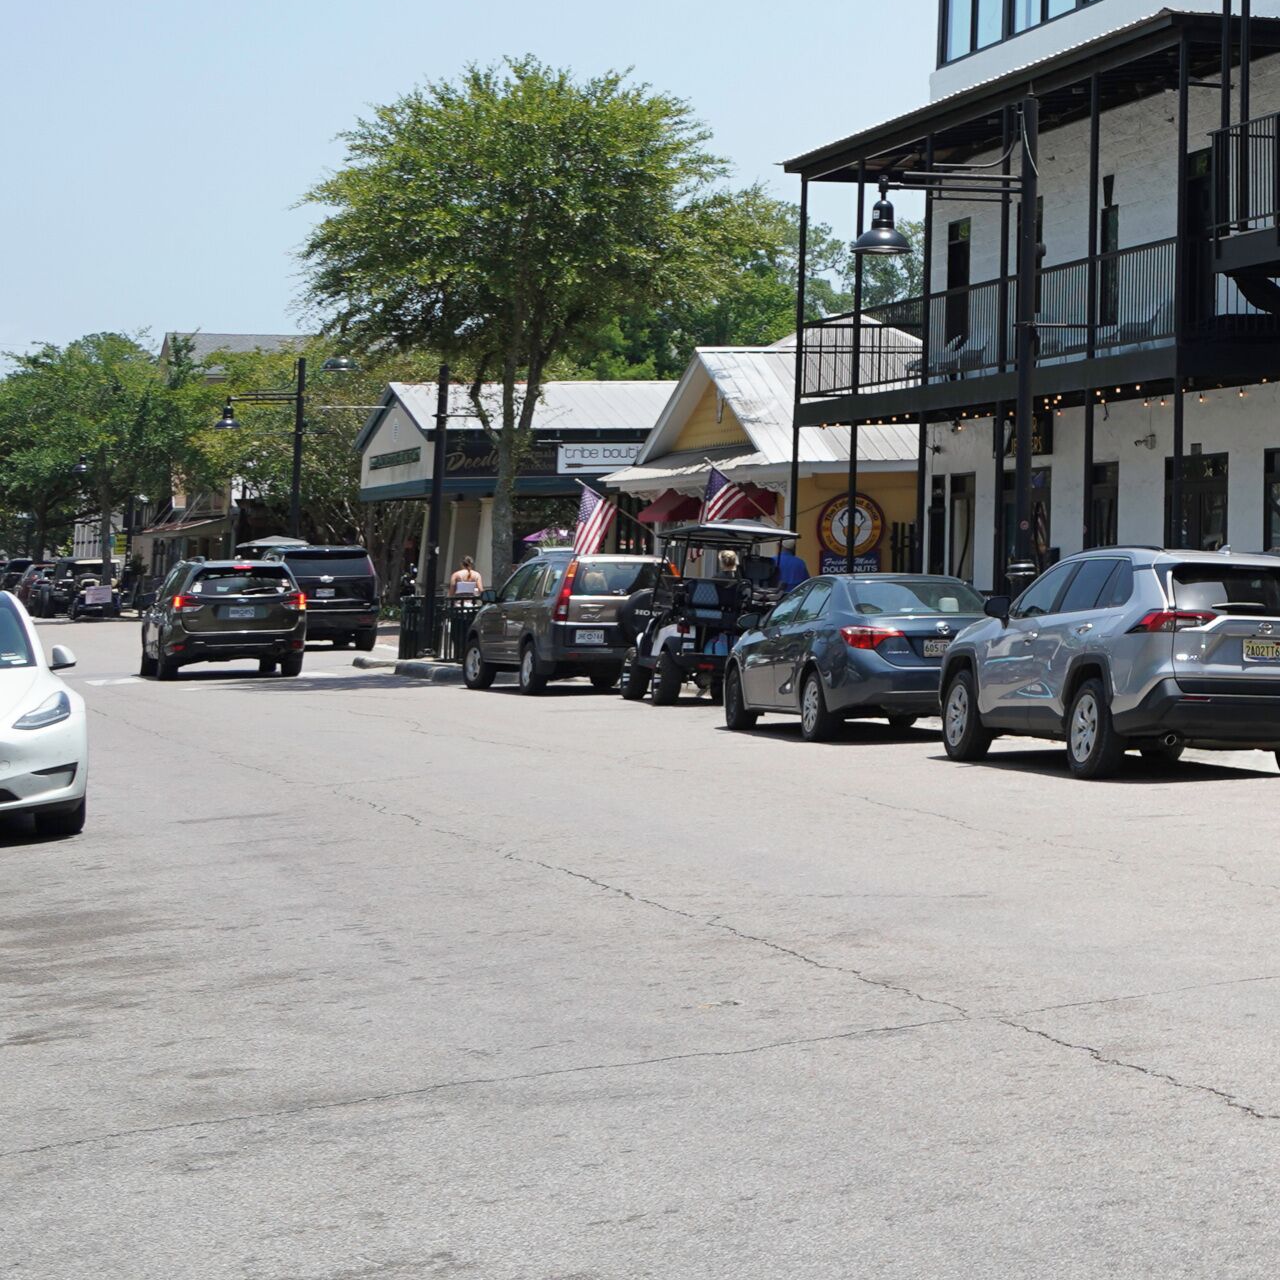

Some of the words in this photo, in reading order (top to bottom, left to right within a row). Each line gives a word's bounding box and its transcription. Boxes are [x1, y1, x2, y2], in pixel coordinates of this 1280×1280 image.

[564, 446, 598, 459] tribe
[602, 446, 641, 459] bouti
[925, 643, 939, 653] 605
